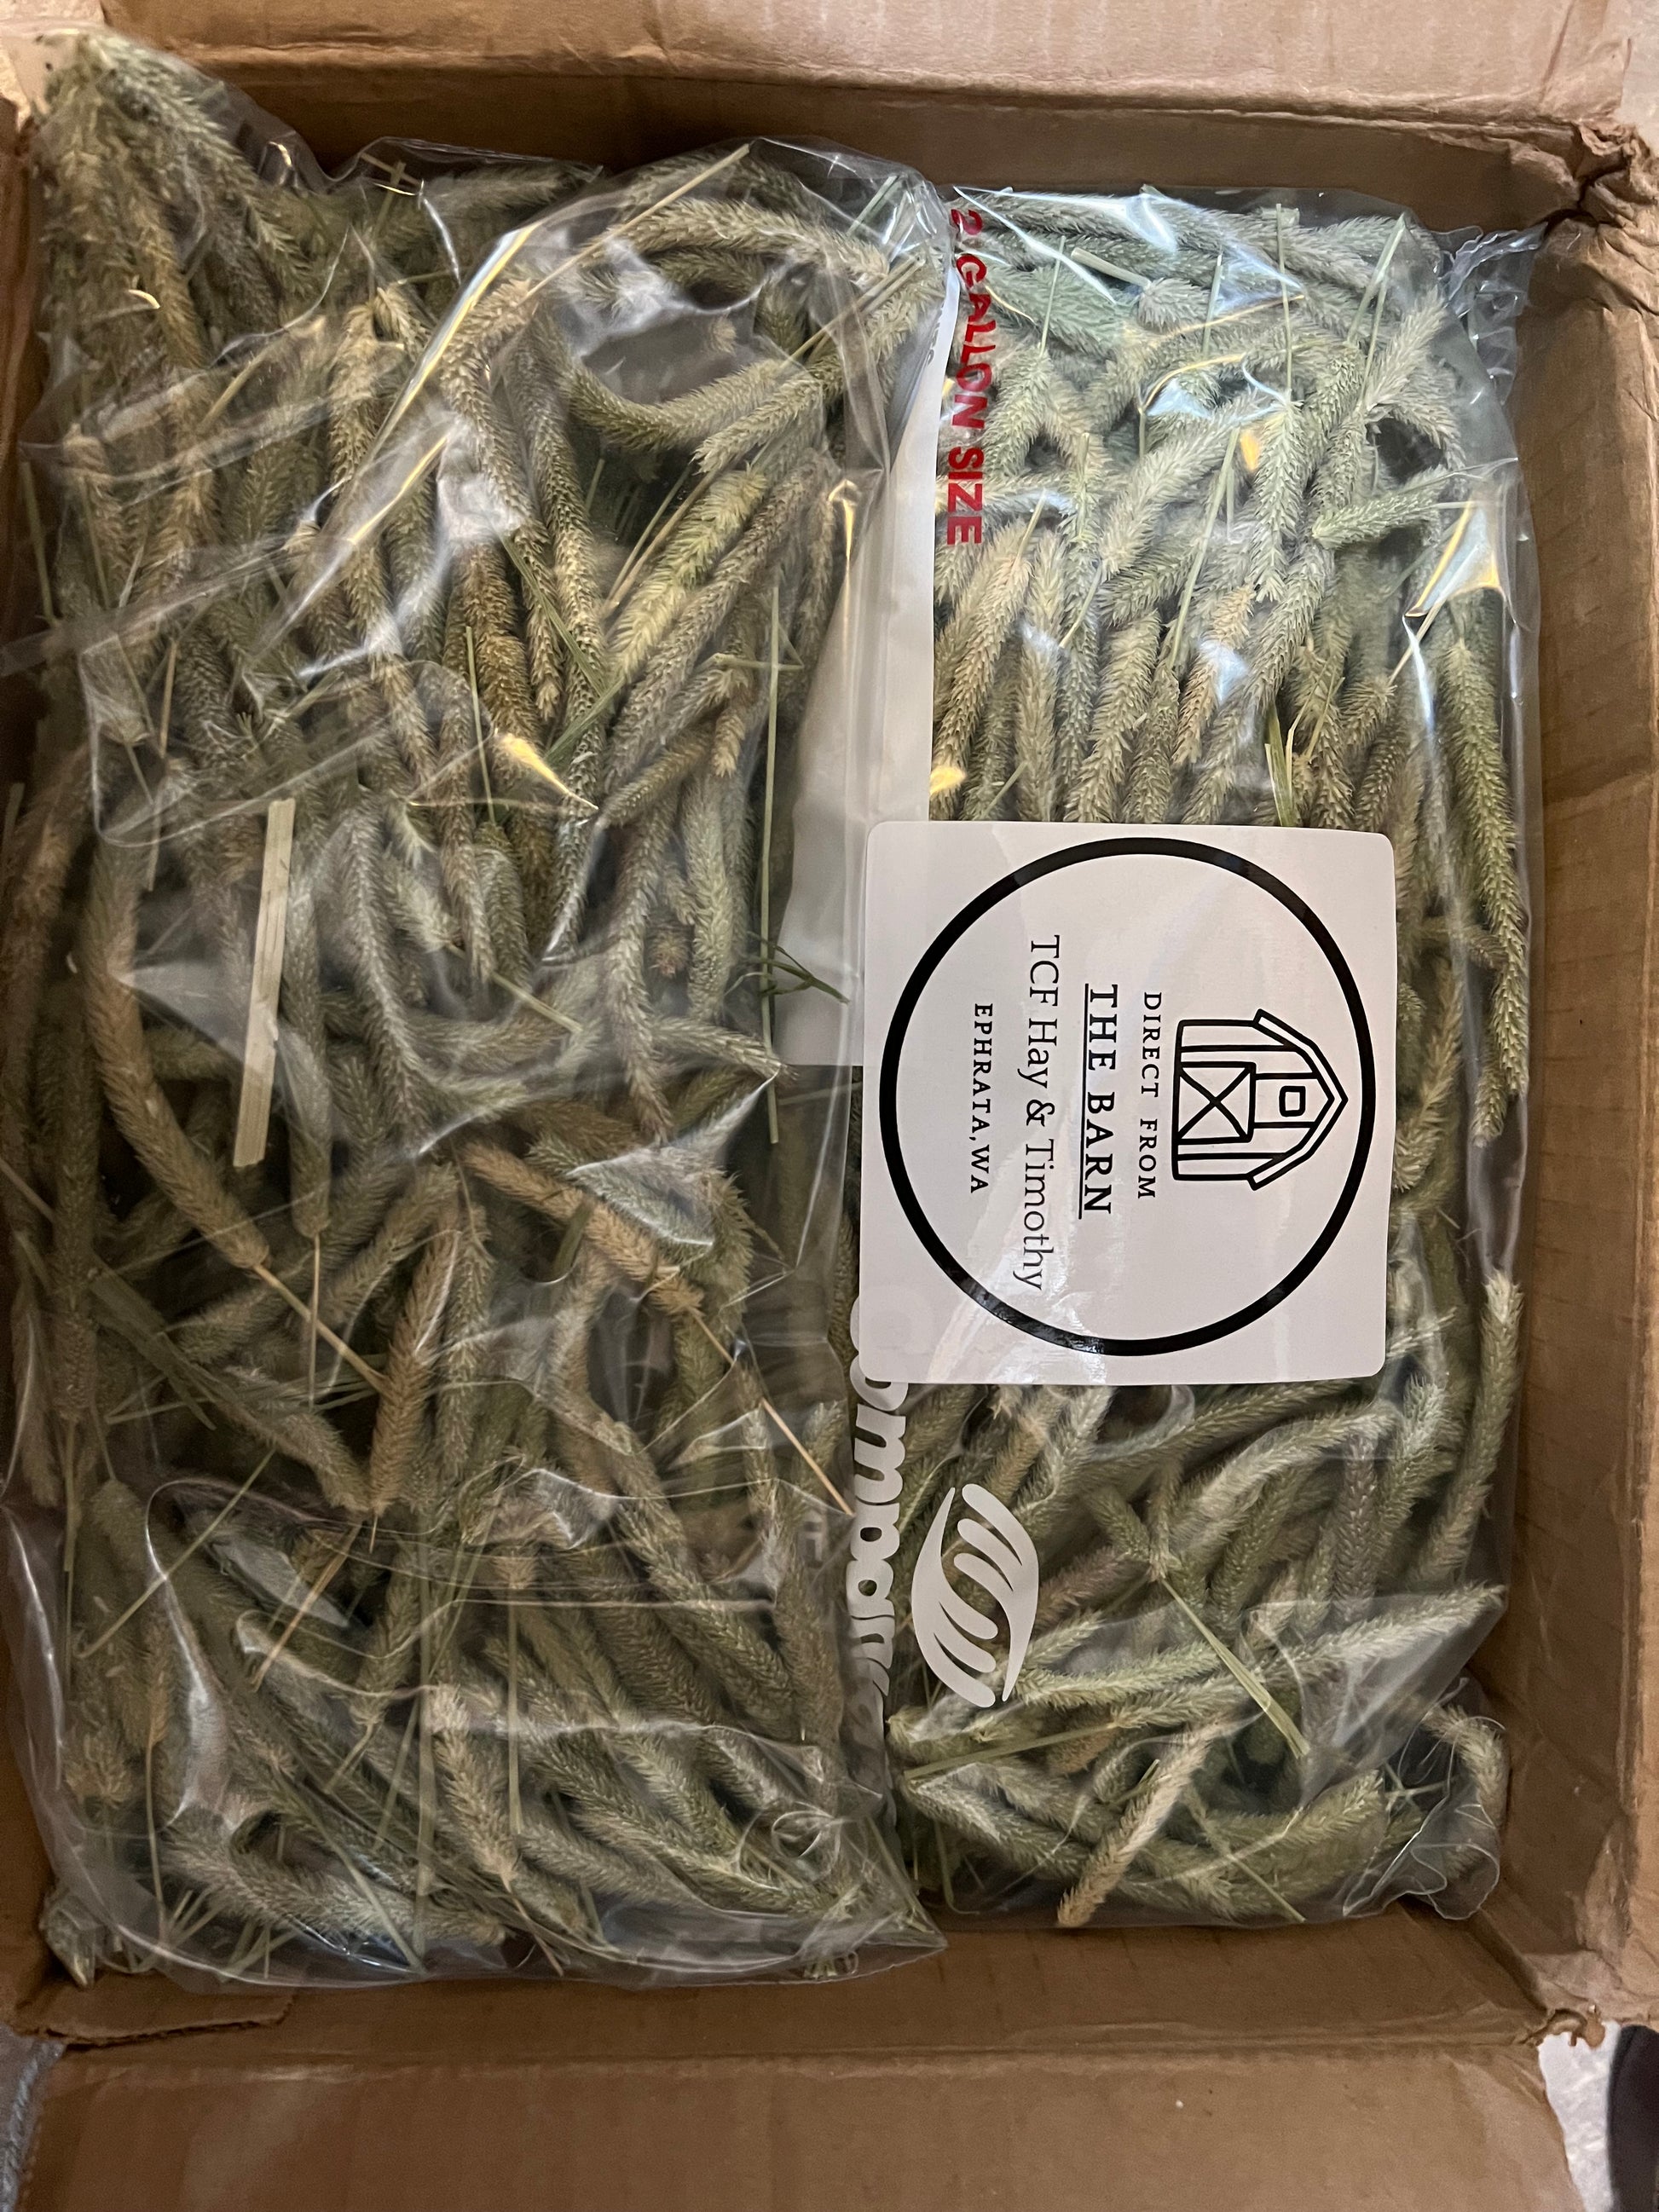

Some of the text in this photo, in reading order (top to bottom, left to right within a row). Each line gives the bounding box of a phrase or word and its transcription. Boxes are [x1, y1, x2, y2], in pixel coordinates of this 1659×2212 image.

[946, 209, 997, 546] 2 GALLON SIZE
[1012, 934, 1061, 1291] TCF Hay & Timothy
[1083, 983, 1119, 1215] THE BARN
[1137, 991, 1163, 1199] DIRECT FROM
